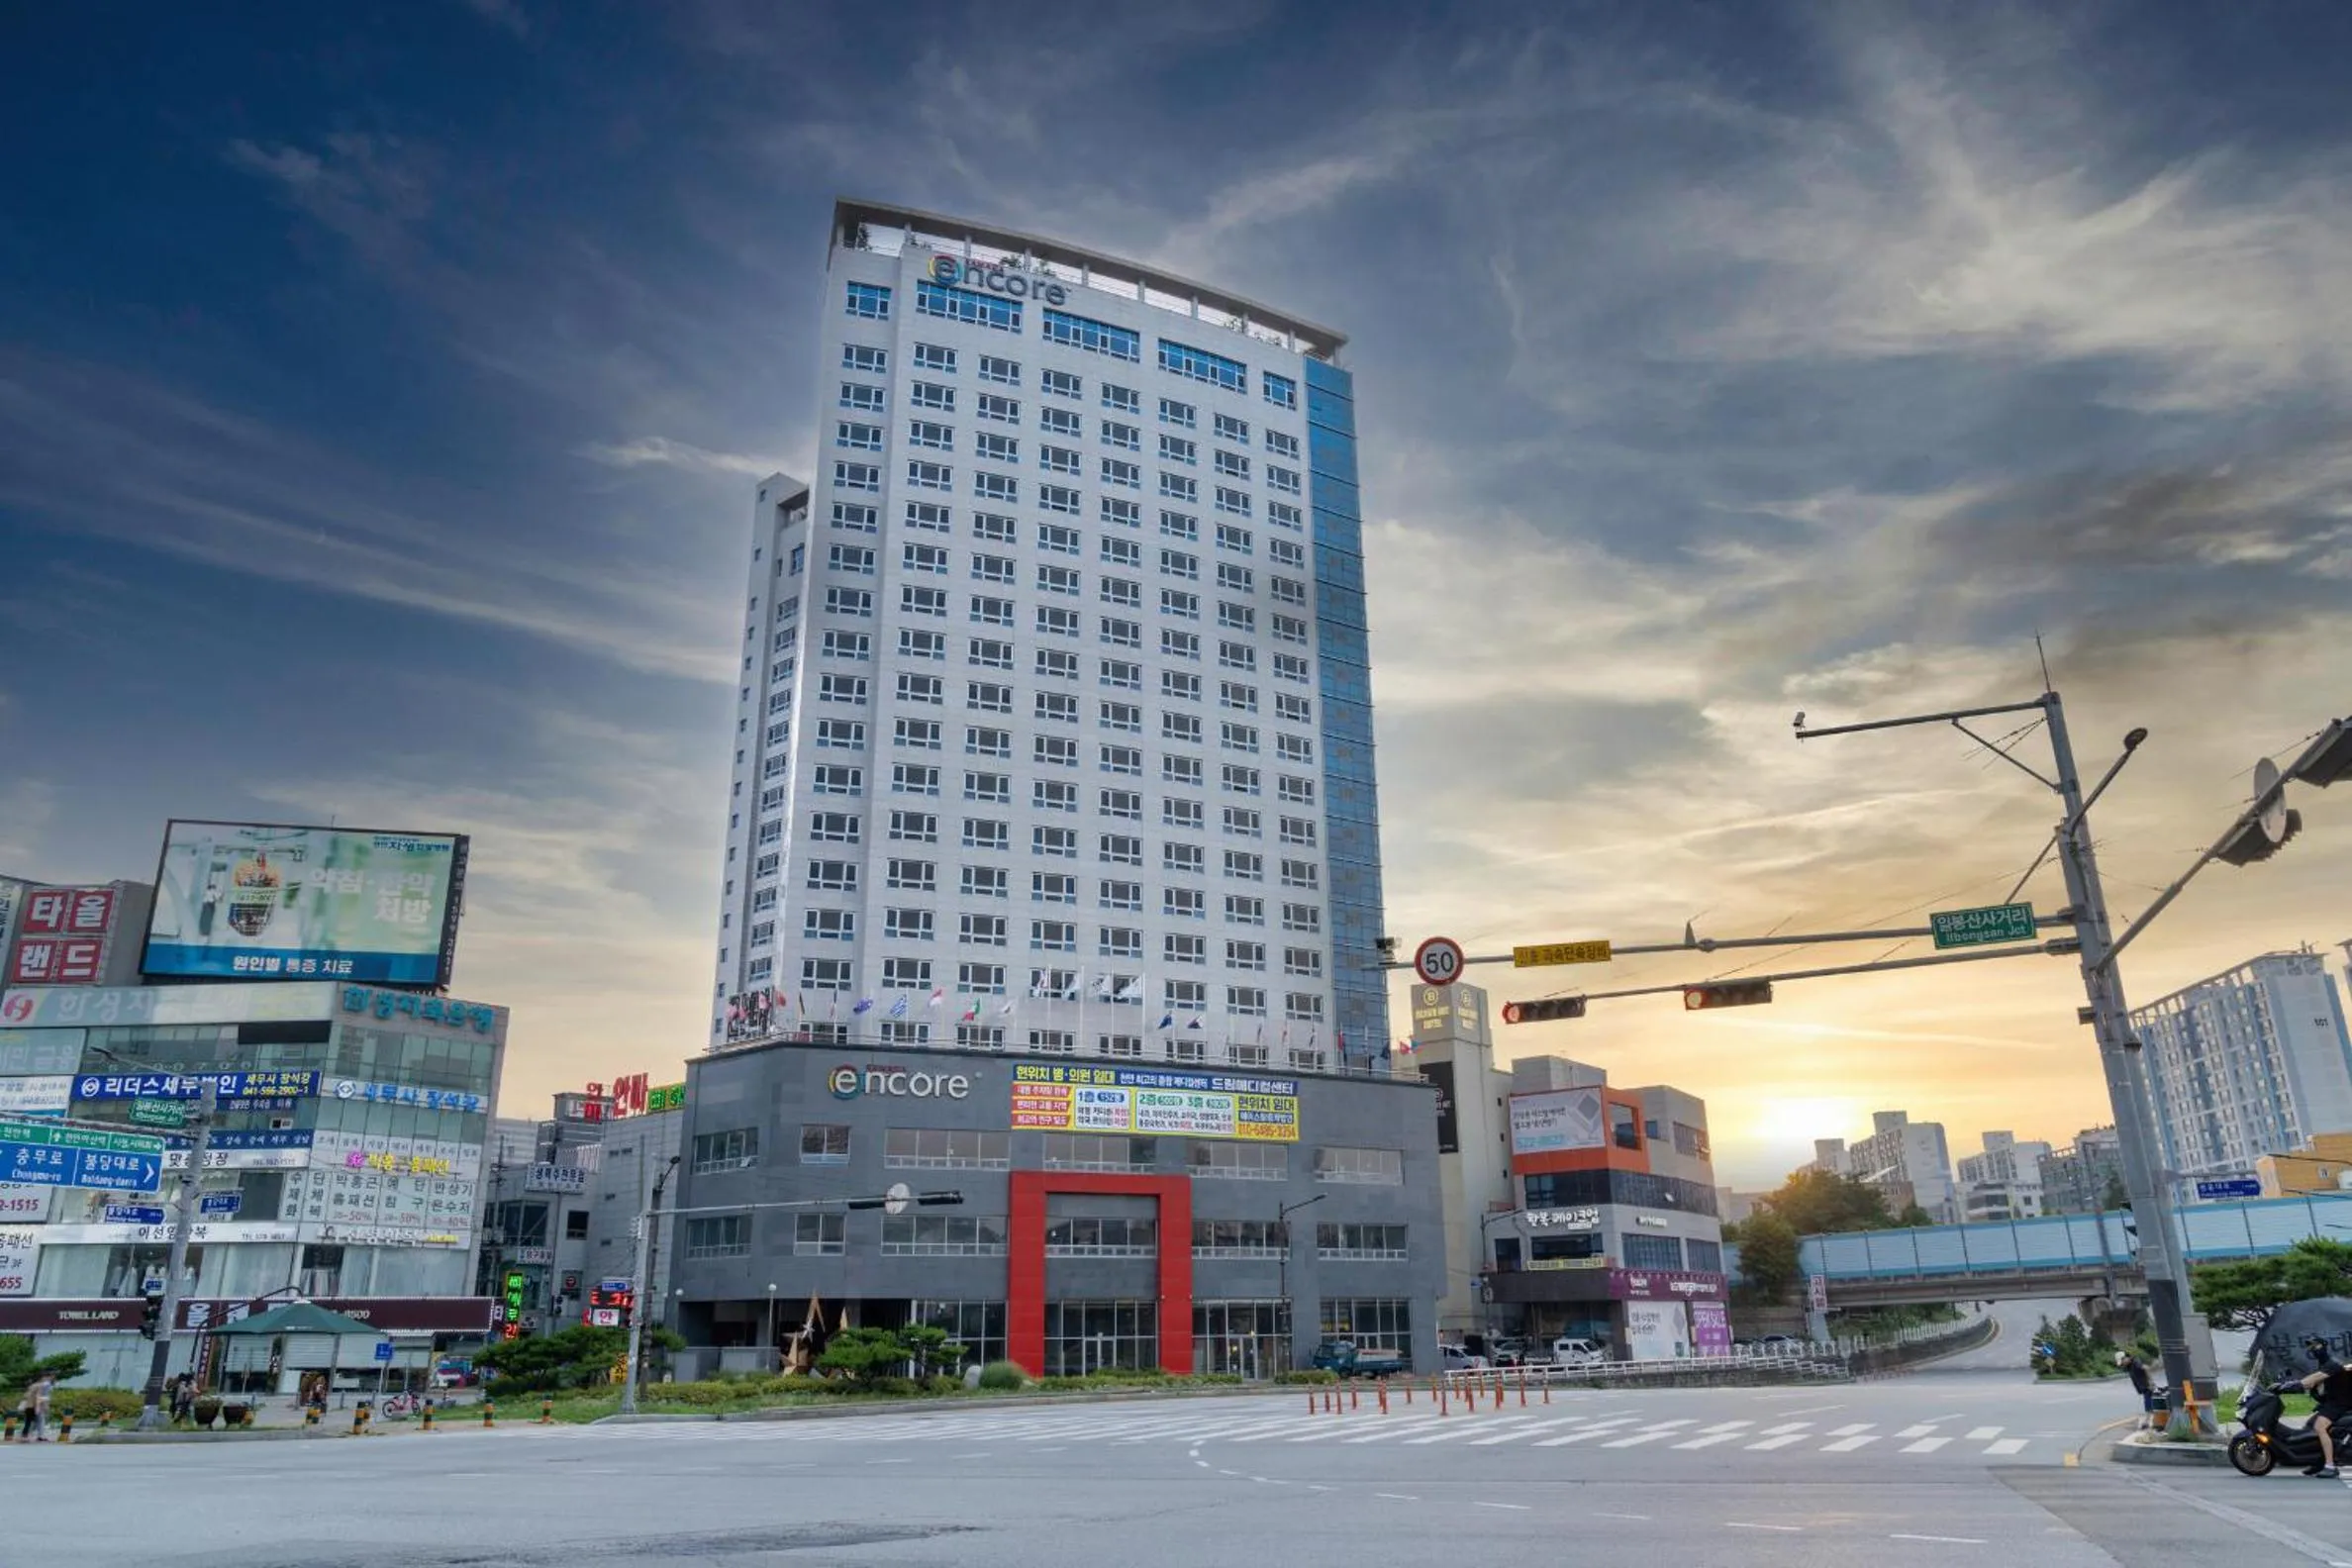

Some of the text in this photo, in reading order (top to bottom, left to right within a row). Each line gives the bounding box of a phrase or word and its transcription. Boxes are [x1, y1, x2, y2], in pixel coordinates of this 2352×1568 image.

[931, 255, 1065, 306] encore
[32, 895, 106, 928] 타올
[1936, 907, 2028, 932] 일봉산사거리
[20, 944, 96, 977] 랜드
[323, 958, 354, 973] 치료
[1425, 953, 1454, 974] 50
[831, 1065, 969, 1099] encore
[16, 1148, 63, 1165] 충무로
[85, 1153, 140, 1171] 불당대로
[139, 1225, 207, 1239] 이선영복
